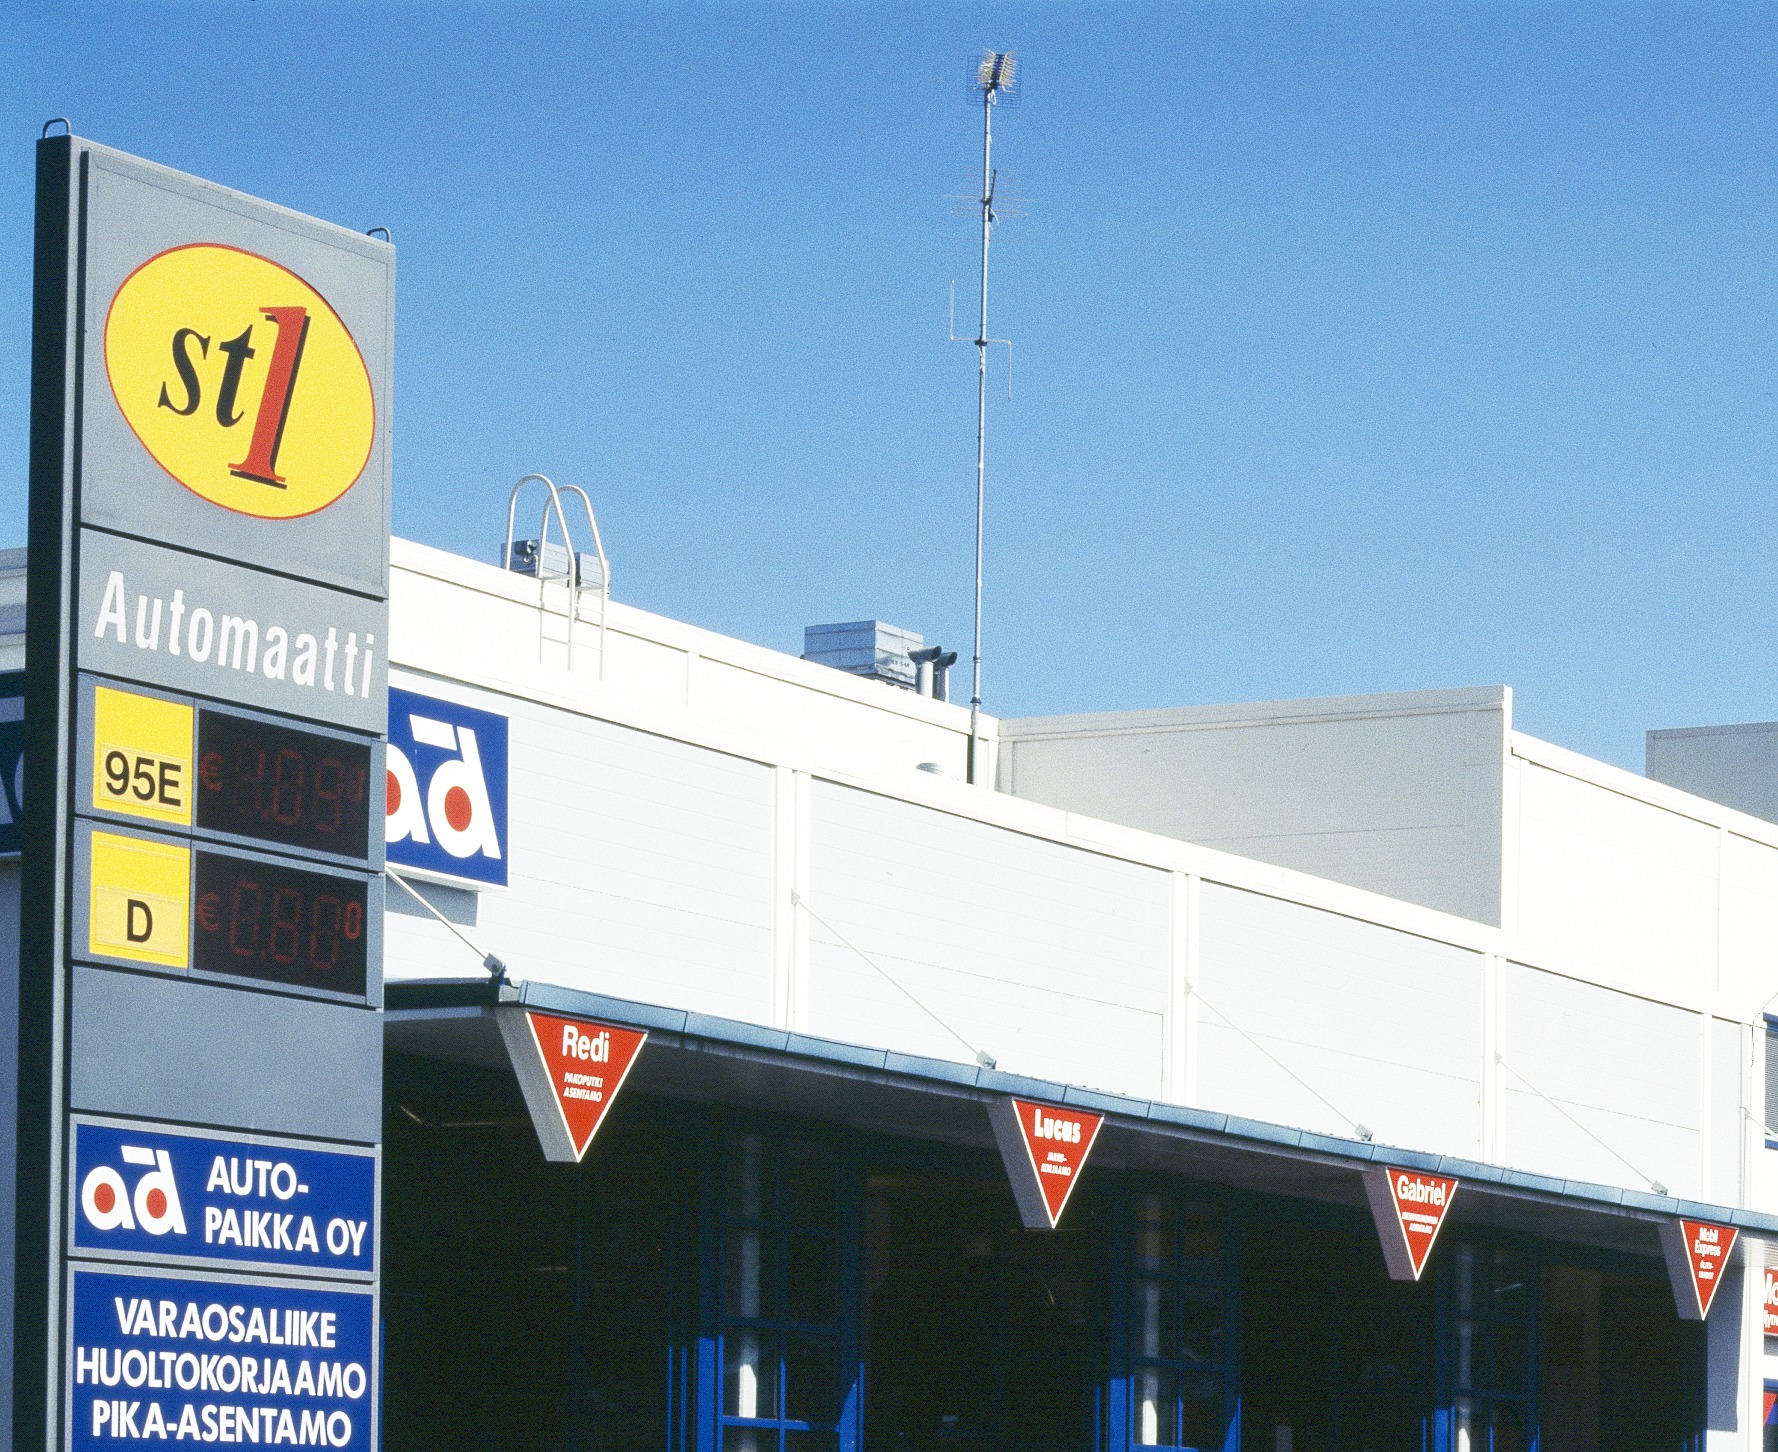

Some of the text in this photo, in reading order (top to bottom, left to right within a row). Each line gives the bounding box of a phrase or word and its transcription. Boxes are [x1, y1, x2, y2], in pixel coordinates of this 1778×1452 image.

[157, 306, 311, 490] st1
[94, 570, 376, 700] Automaatti
[105, 751, 182, 808] 95E
[127, 899, 153, 943] D
[562, 1025, 610, 1063] Redi
[563, 1087, 602, 1102] ASENTAMO
[564, 1072, 603, 1088] PAKOPUTKI
[1034, 1108, 1081, 1143] Lucas
[206, 1156, 309, 1201] AUTO-
[1397, 1175, 1446, 1206] Gabriel
[205, 1206, 367, 1257] PAIKKA OY
[1695, 1240, 1720, 1257] Express
[1699, 1227, 1719, 1243] Mobil
[114, 1296, 336, 1348] VARAOSALIIKE
[76, 1346, 367, 1399] HUOLTOKORJAAMO
[92, 1400, 352, 1448] PIKA-ASENTAMO
